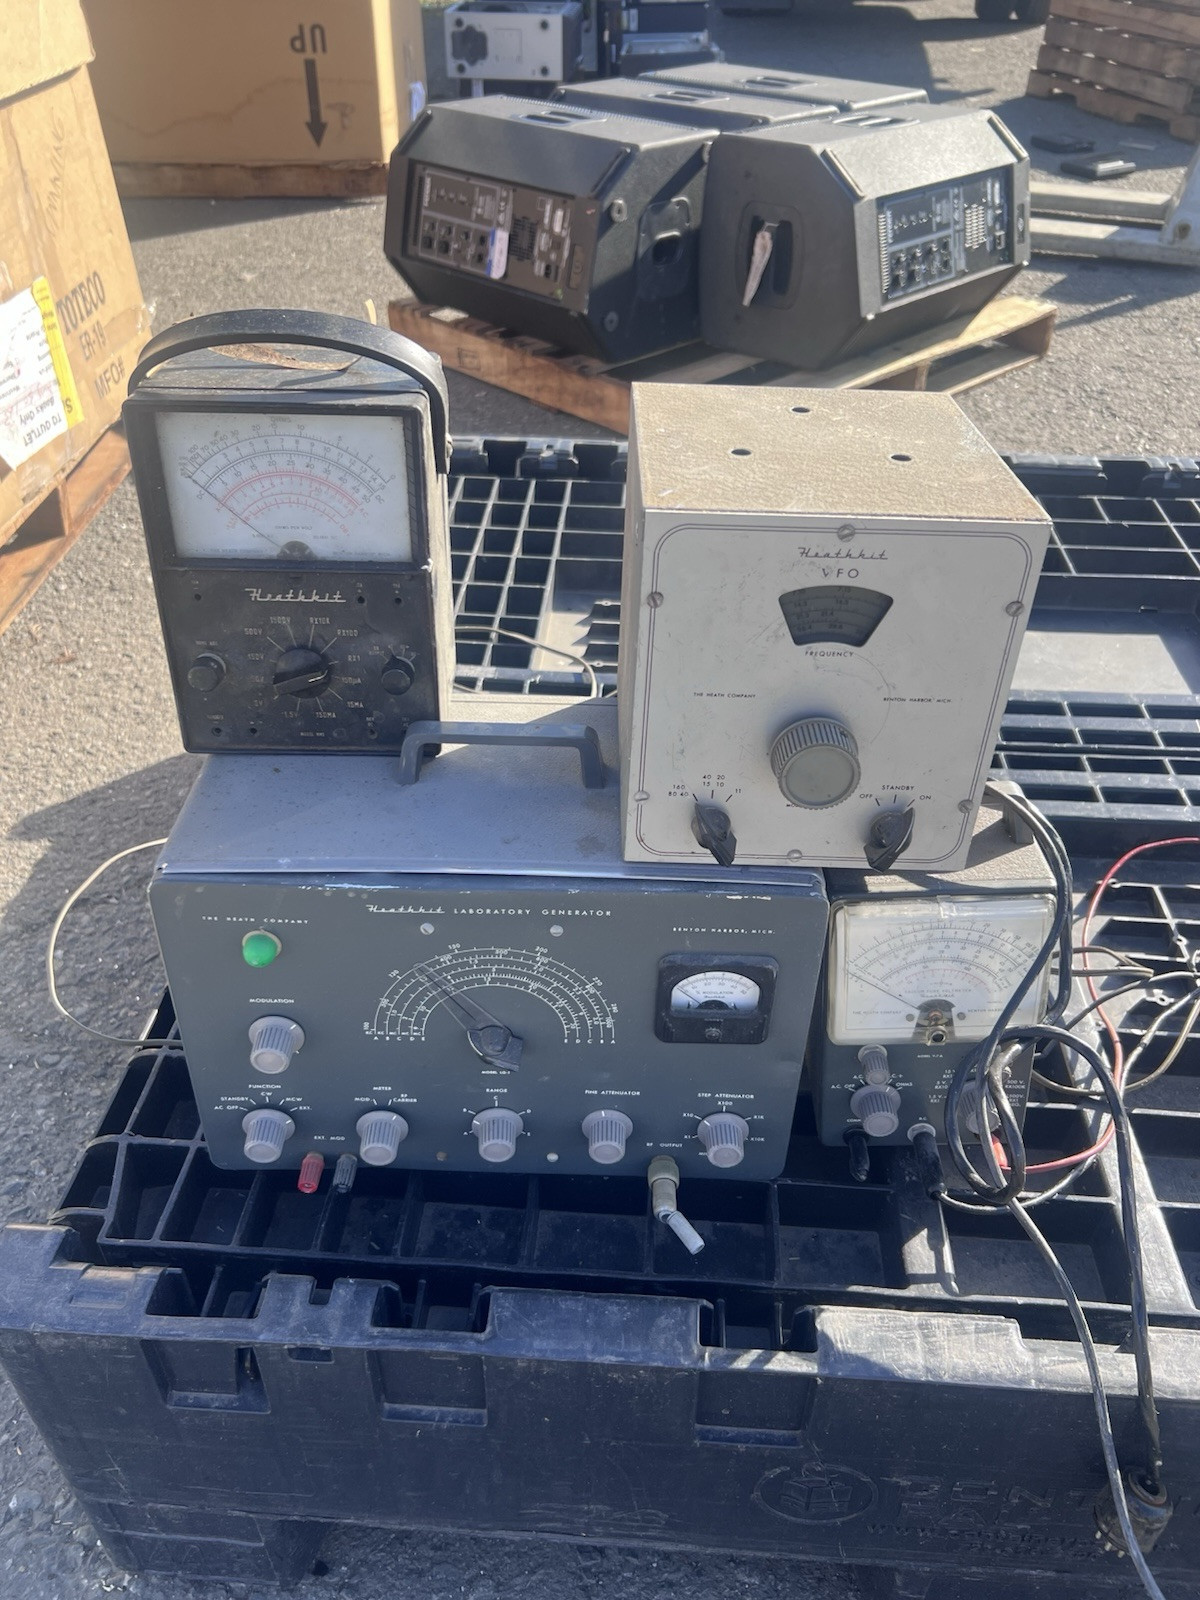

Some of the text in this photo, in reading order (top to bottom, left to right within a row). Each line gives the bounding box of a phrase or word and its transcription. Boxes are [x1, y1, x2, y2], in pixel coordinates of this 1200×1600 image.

[290, 23, 327, 54] UP
[56, 271, 105, 336] TOTECO
[79, 320, 107, 361] ER-19
[20, 410, 35, 425] Only
[23, 412, 62, 447] TO OUTLET
[797, 546, 889, 560] Heathkit
[821, 567, 859, 579] VFO
[244, 588, 346, 602] Heathkit
[244, 627, 262, 635] 500V
[347, 701, 364, 709] 15MA
[366, 904, 446, 914] Heathkit
